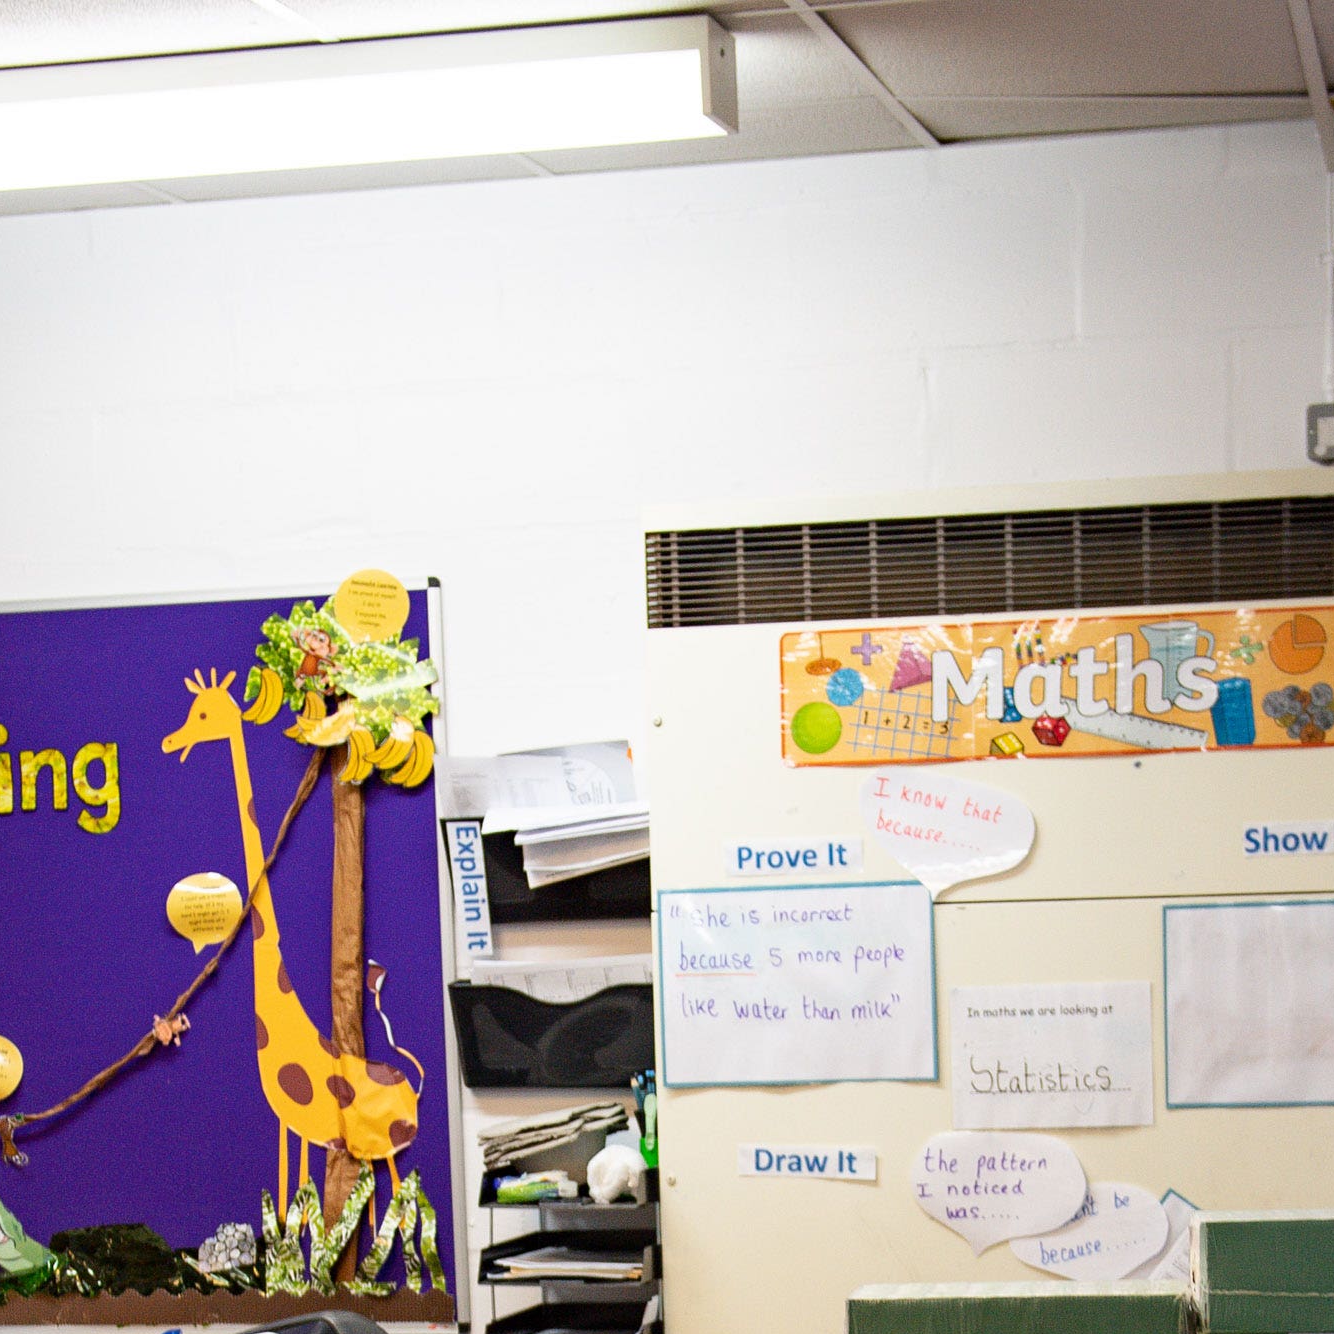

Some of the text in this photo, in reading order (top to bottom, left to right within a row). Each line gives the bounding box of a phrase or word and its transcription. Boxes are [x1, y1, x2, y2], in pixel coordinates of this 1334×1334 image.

[931, 633, 1219, 723] Maths
[902, 715, 912, 730] 2
[939, 721, 950, 735] 3
[873, 777, 1003, 824] I know that
[1244, 825, 1331, 854] Show
[737, 843, 848, 870] Prove It
[454, 826, 488, 950] Explain It
[741, 908, 761, 924] is
[772, 903, 853, 923] incorrect
[679, 940, 905, 974] because 5 more people
[681, 992, 719, 1018] like
[733, 1000, 788, 1021] water
[803, 996, 841, 1020] than
[967, 1004, 1113, 1018] In maths we are looking at
[969, 1055, 1113, 1096] Statistics
[754, 1148, 857, 1174] Draw It
[924, 1148, 1048, 1178] the pattern
[917, 1179, 1025, 1198] I noticed
[1113, 1191, 1131, 1209] be
